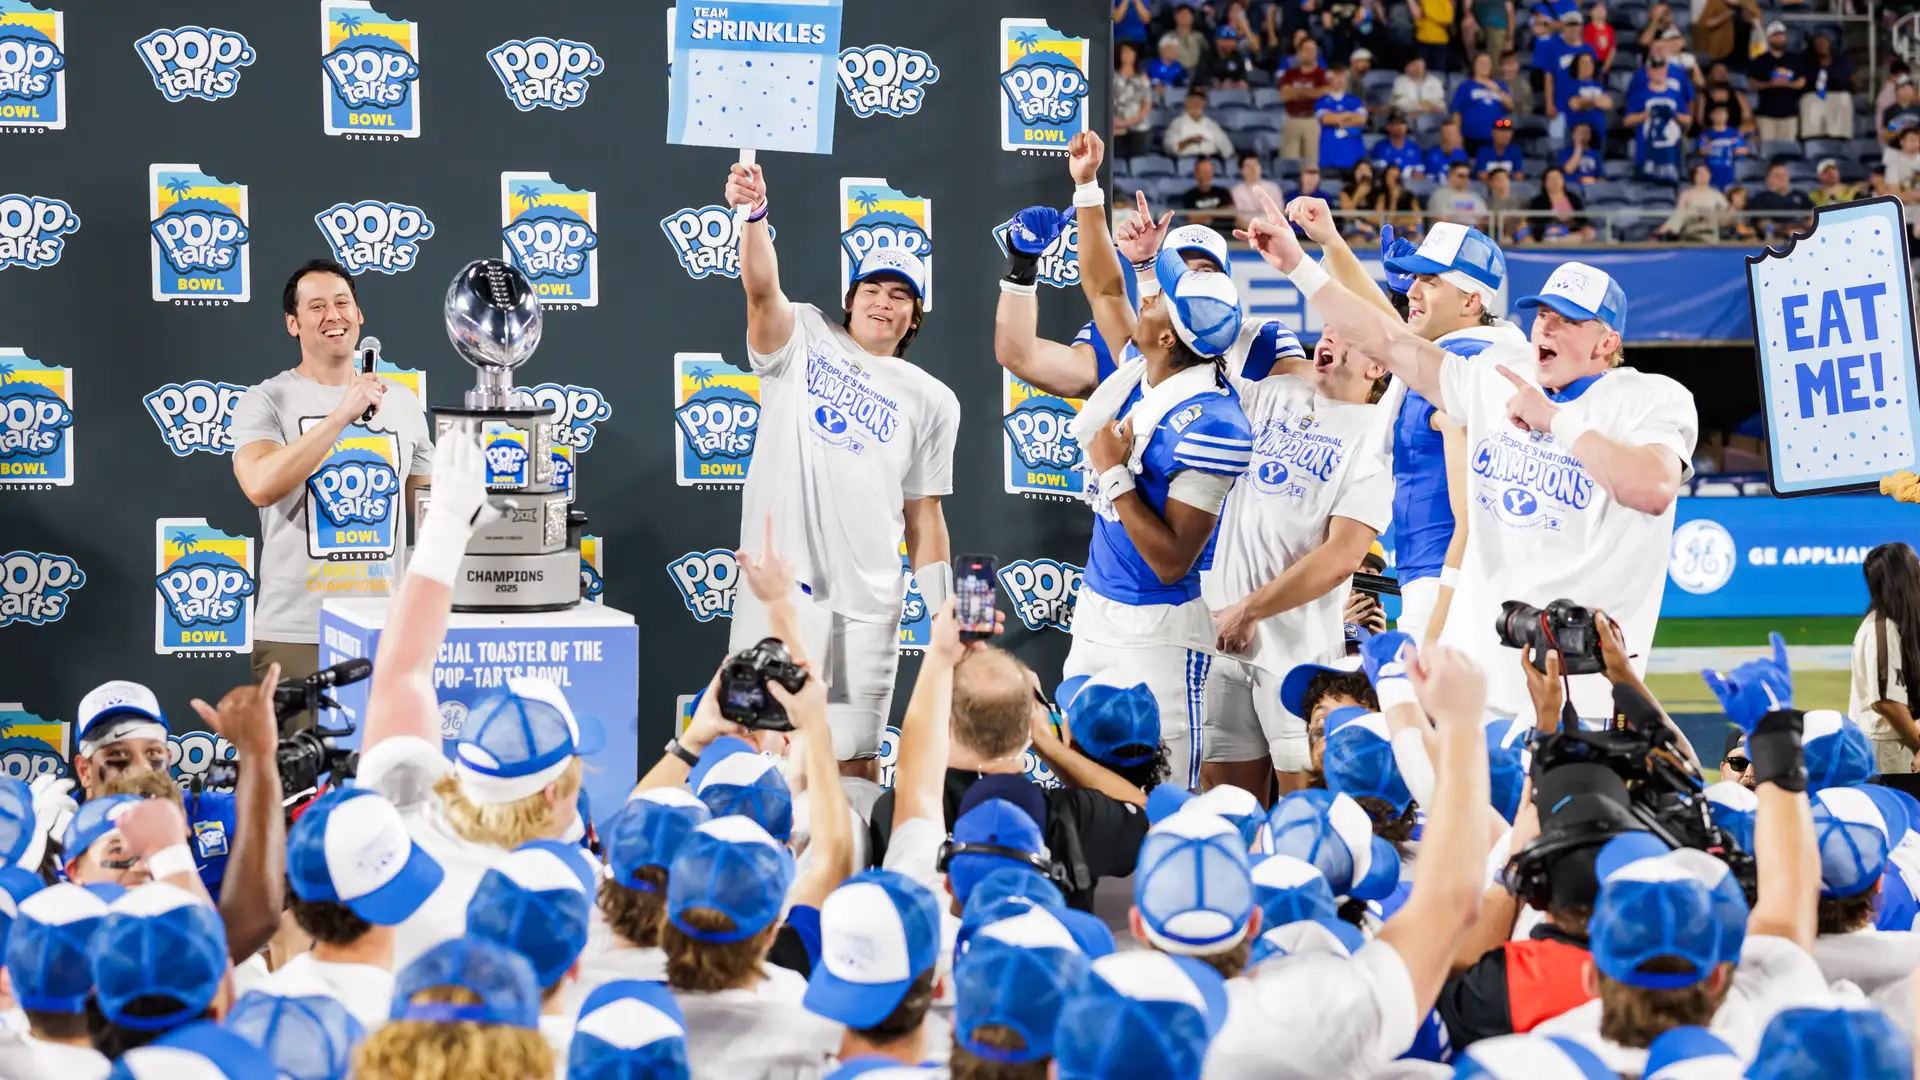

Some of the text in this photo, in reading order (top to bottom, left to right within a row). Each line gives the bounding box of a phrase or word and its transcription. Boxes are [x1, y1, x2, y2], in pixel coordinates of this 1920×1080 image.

[693, 7, 729, 18] TEAM
[691, 18, 826, 45] SPRINKLES
[0, 105, 40, 118] OWL
[349, 113, 395, 126] BOWL
[346, 134, 400, 142] ORLANDO
[1024, 129, 1066, 142] BOWL
[1021, 149, 1070, 158] ORLANDO
[685, 246, 741, 274] tart
[178, 278, 224, 291] BOWL
[174, 299, 229, 307] ORLANDO
[1781, 282, 1887, 352] EAT
[817, 357, 859, 388] PEOPLE'S
[857, 383, 899, 412] NATIONAL
[1795, 352, 1887, 419] ME!
[1303, 432, 1343, 448] NATIONAL
[1500, 433, 1539, 456] PEOPLE'S
[700, 463, 744, 476] BOWL
[1471, 438, 1594, 510] CHAMPIONS
[1027, 472, 1068, 487] BOWL
[1024, 493, 1072, 503] ORLANDO
[335, 530, 381, 544] BOWL
[1748, 546, 1778, 566] GE
[466, 570, 544, 582] CHAMPIONS
[495, 584, 518, 592] 2025
[181, 630, 227, 643] BOWL
[177, 651, 232, 659] ORLANDO
[477, 639, 548, 663] TOASTER
[550, 640, 570, 663] OF
[572, 640, 604, 663] THE
[434, 665, 524, 689] POP-TARTS
